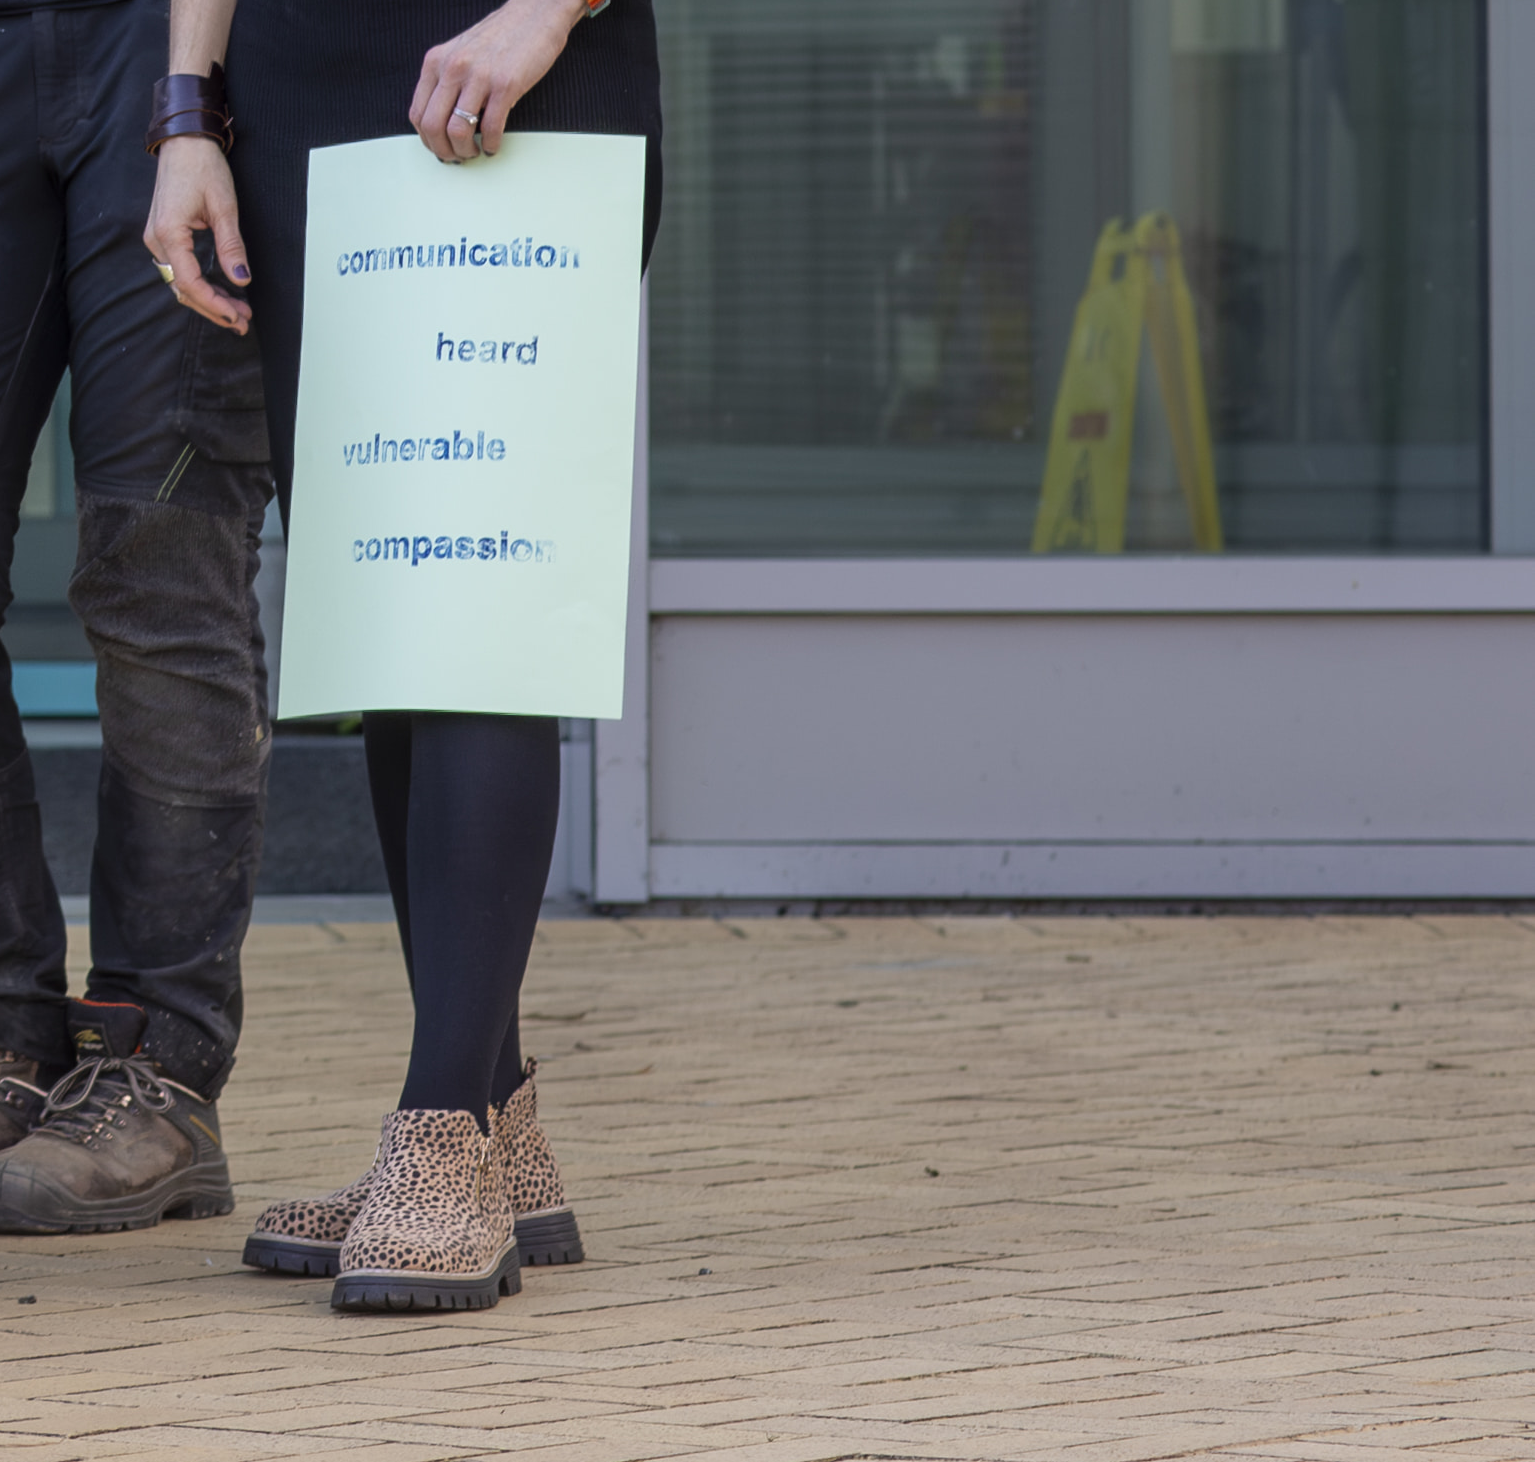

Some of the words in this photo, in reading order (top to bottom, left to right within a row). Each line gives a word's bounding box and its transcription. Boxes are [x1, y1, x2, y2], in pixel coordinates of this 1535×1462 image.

[337, 237, 580, 276] communication
[436, 332, 538, 365] heard
[343, 430, 506, 466] vulnerable
[353, 530, 557, 567] compassion
